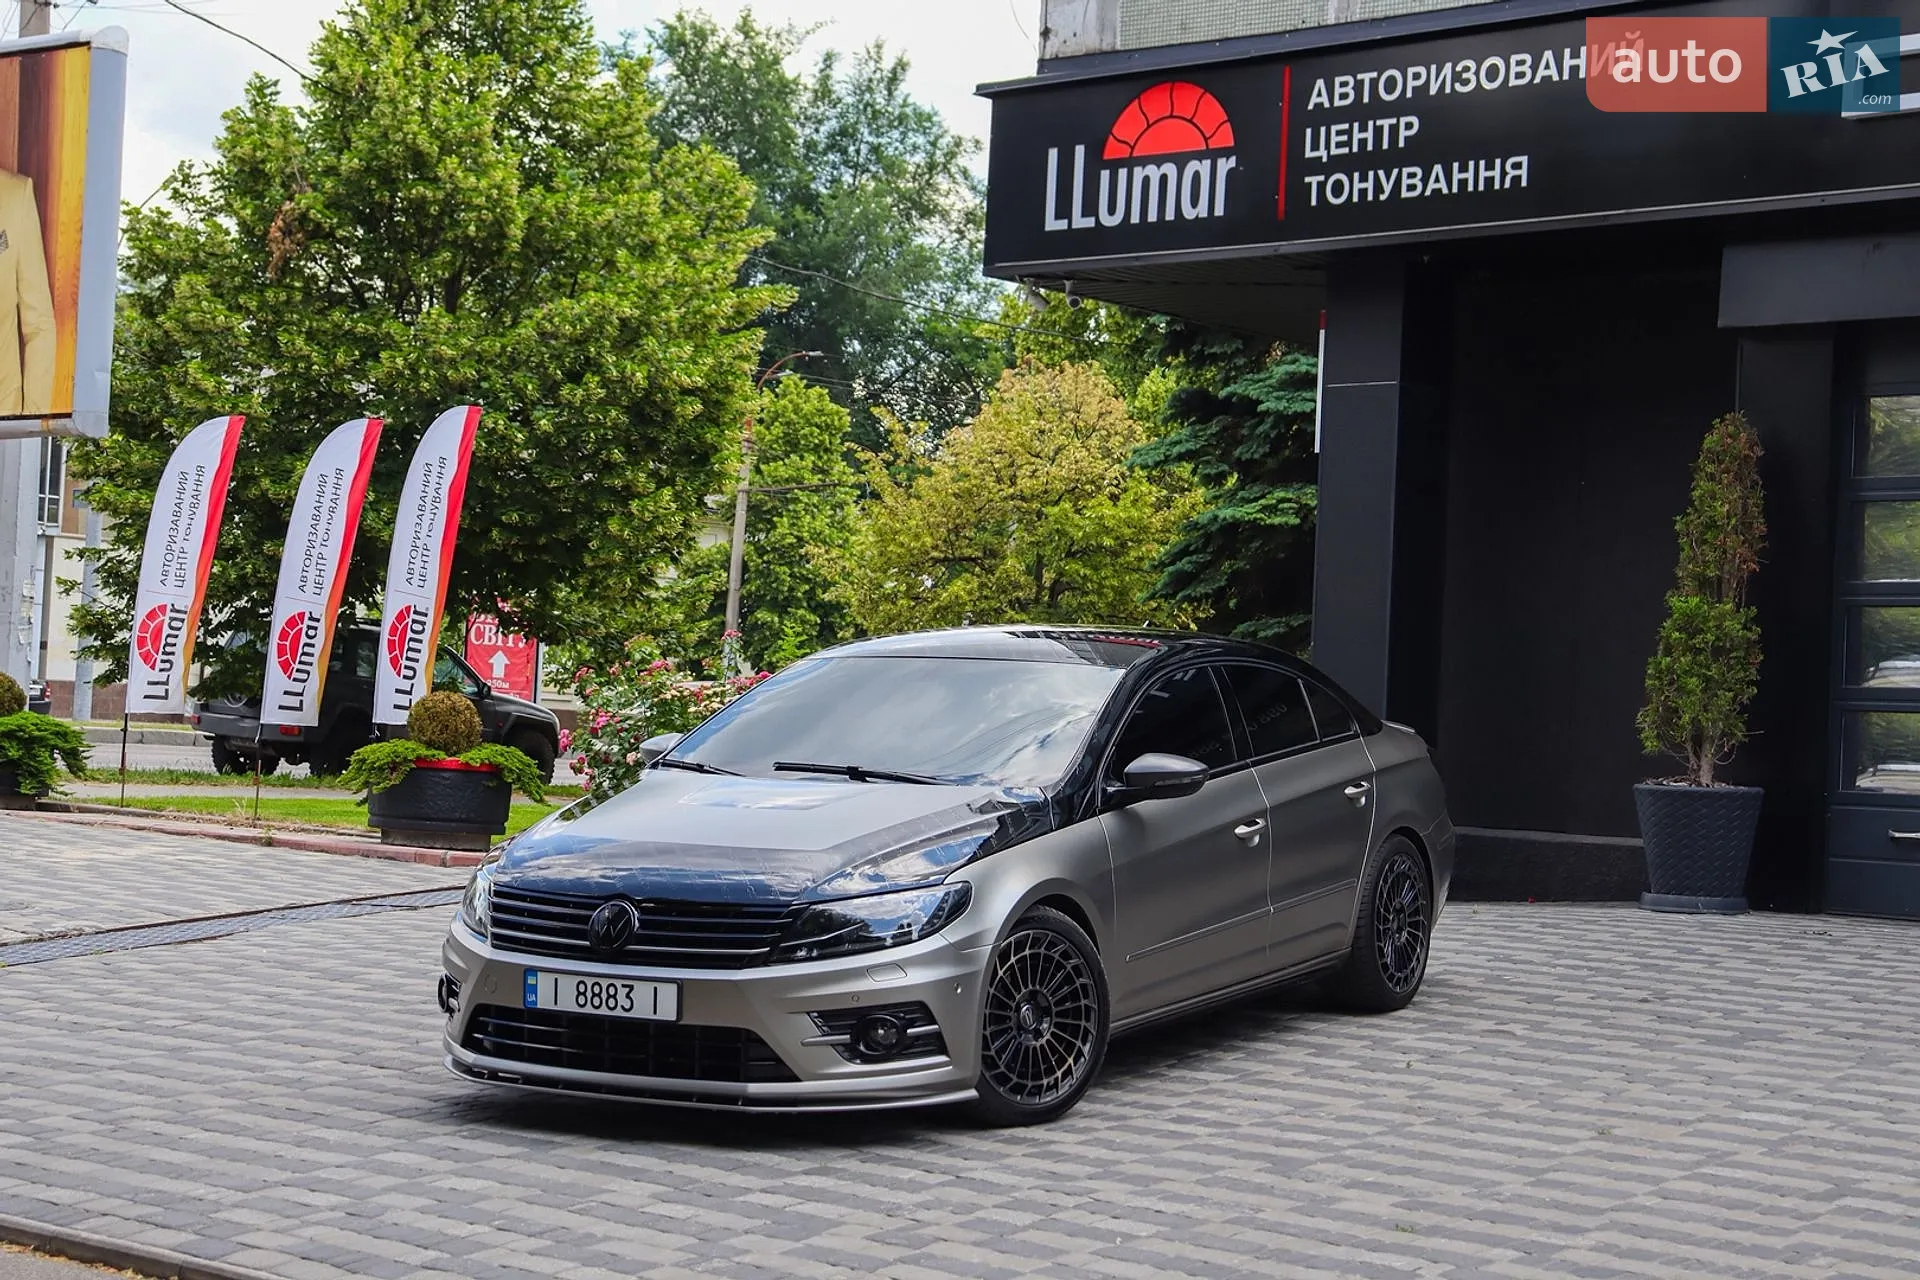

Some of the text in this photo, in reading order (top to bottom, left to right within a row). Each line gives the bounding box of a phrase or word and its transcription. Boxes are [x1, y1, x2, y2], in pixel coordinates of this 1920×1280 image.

[1307, 30, 1645, 110] АВТОРИЗОВАНИЙ
[1304, 115, 1420, 163] ЦЕНТР
[1044, 143, 1237, 231] LLumar
[1304, 155, 1529, 206] ТОНУВАННЯ
[173, 545, 189, 588] ЦЕНТР
[311, 550, 328, 596] ЦЕНТР
[416, 541, 432, 588] ЦЕНТР
[143, 603, 188, 701] LLumar
[278, 611, 321, 712] LLumar
[393, 604, 429, 710] LLumar
[527, 992, 537, 1002] UA
[575, 980, 635, 1012] 8883
